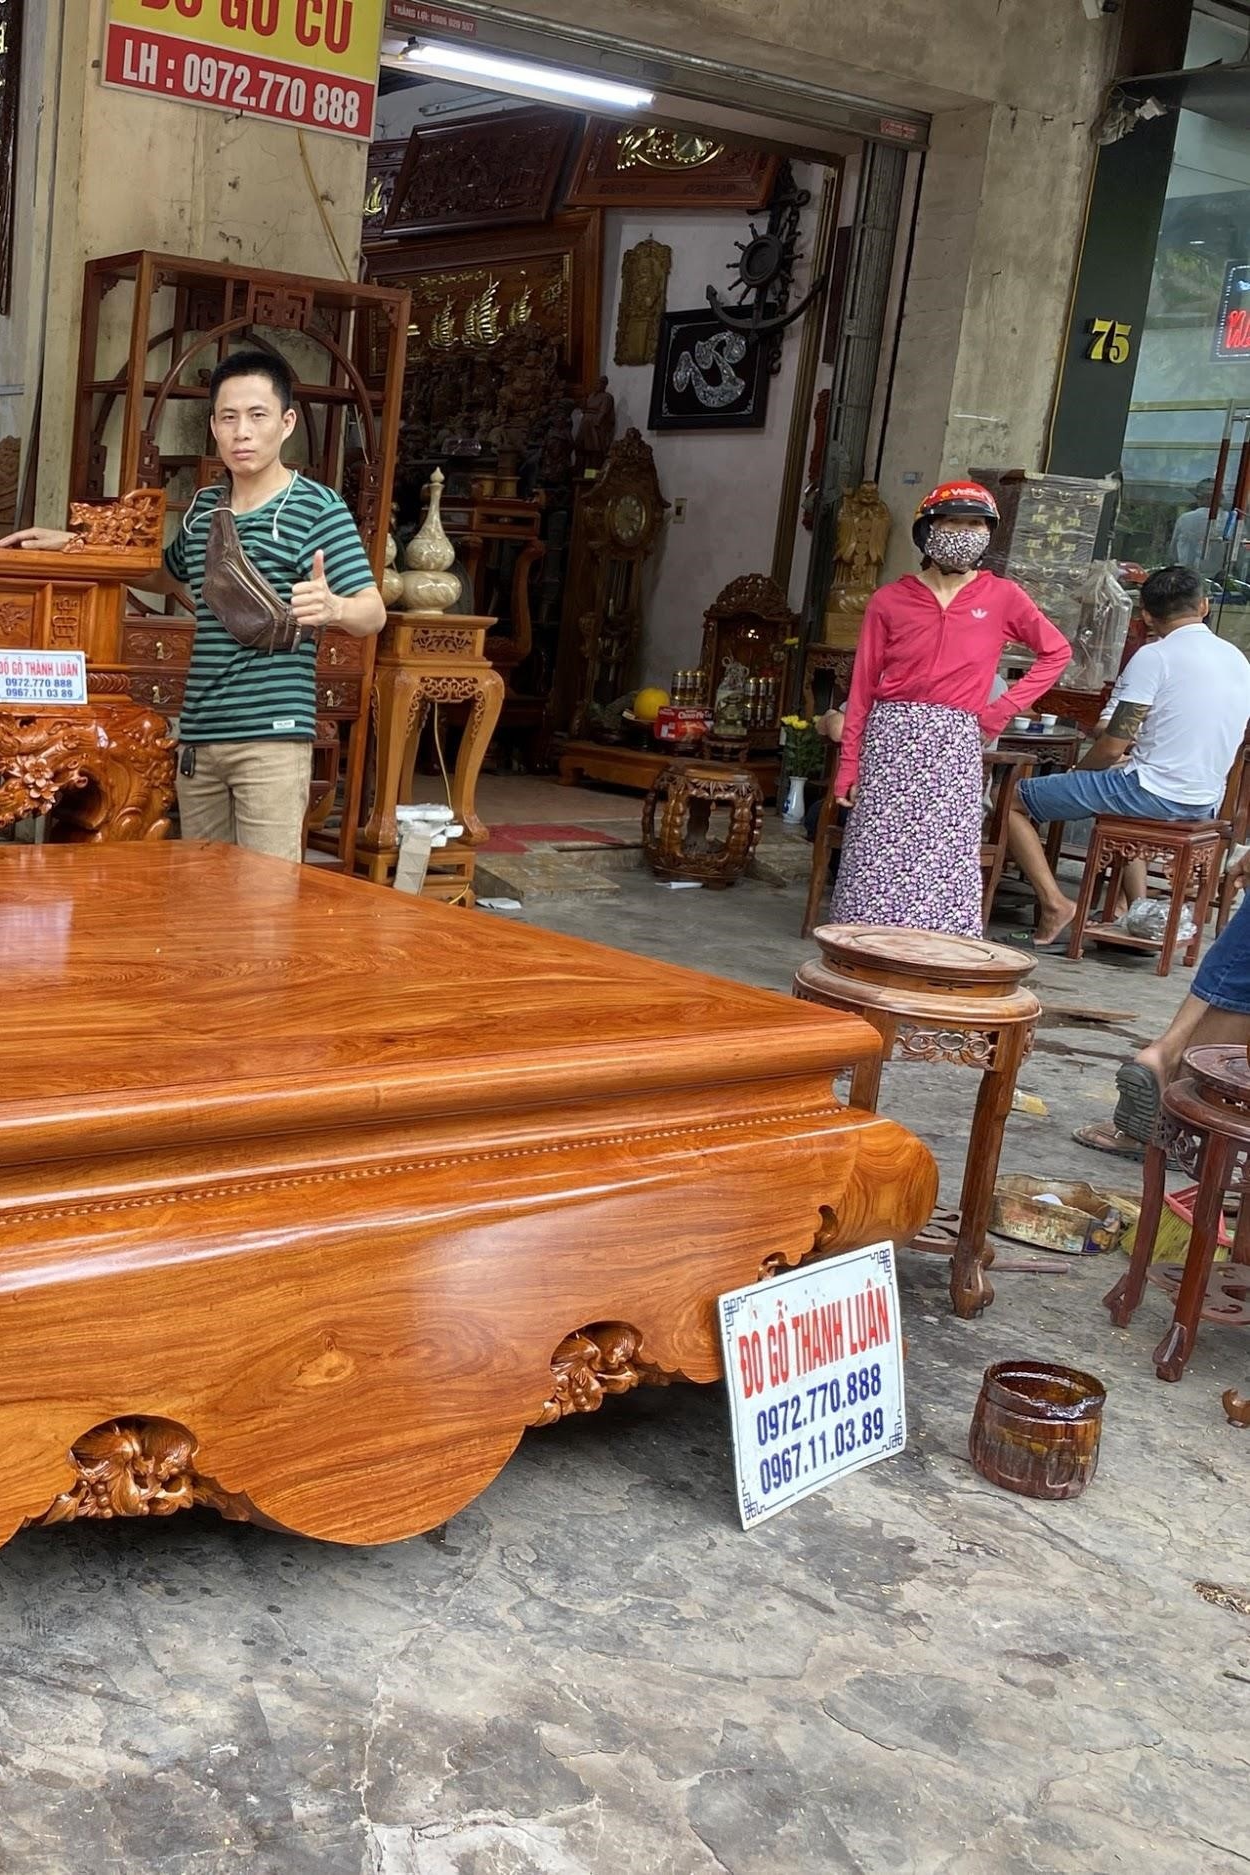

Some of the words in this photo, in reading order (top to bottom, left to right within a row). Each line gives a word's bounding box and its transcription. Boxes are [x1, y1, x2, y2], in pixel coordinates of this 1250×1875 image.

[182, 53, 306, 117] 0972.770
[312, 82, 360, 129] 888
[1090, 318, 1132, 364] 75
[5, 677, 51, 688] 0972.770
[54, 678, 72, 688] 888
[25, 658, 54, 676] THÀNH
[61, 689, 73, 698] 89
[791, 1298, 844, 1377] THÀNH
[847, 1278, 891, 1356] LUÂN
[757, 1362, 882, 1447] 0972.770.888
[759, 1407, 884, 1495] 0967.11.03.89
